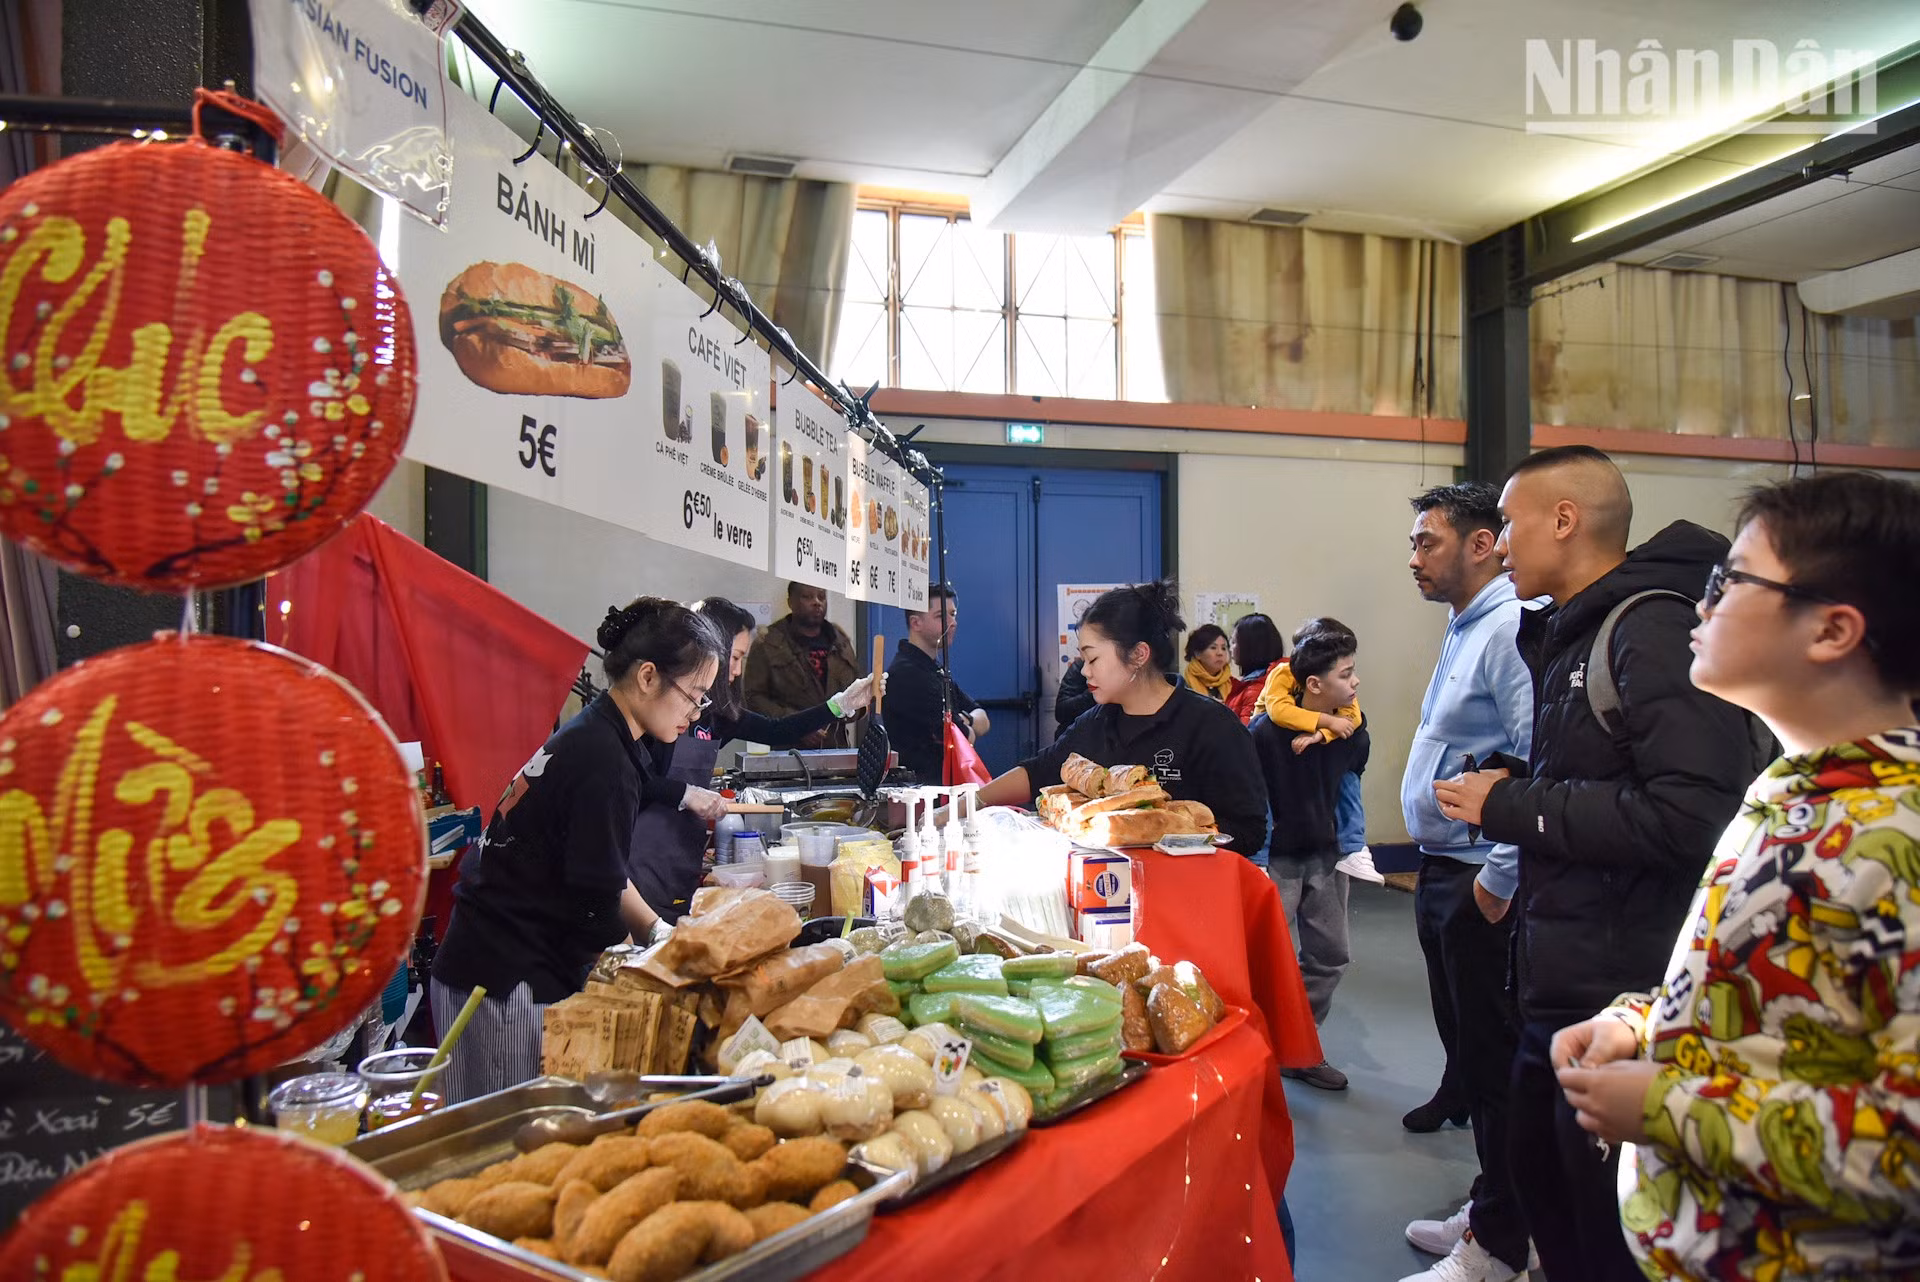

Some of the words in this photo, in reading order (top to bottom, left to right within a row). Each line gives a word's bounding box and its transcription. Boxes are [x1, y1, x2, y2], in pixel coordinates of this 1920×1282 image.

[354, 36, 428, 110] FUSION
[497, 172, 566, 254] BÁNH
[573, 229, 595, 275] MÌ
[688, 326, 721, 372] CAFÉ
[723, 351, 747, 390] VIỆT
[518, 414, 558, 478] 5€
[795, 408, 824, 447] BUBBLE
[825, 430, 839, 457] TEA
[665, 445, 676, 461] PHÊ
[700, 461, 716, 479] CRÈME
[852, 457, 875, 486] BUBBLE
[876, 471, 895, 497] WAFFLE
[713, 512, 723, 540] le
[726, 522, 752, 549] verre
[821, 558, 837, 578] verre
[851, 559, 860, 586] 5€
[869, 564, 878, 590] 6€
[887, 570, 896, 594] 7€
[123, 1101, 178, 1130] 5€
